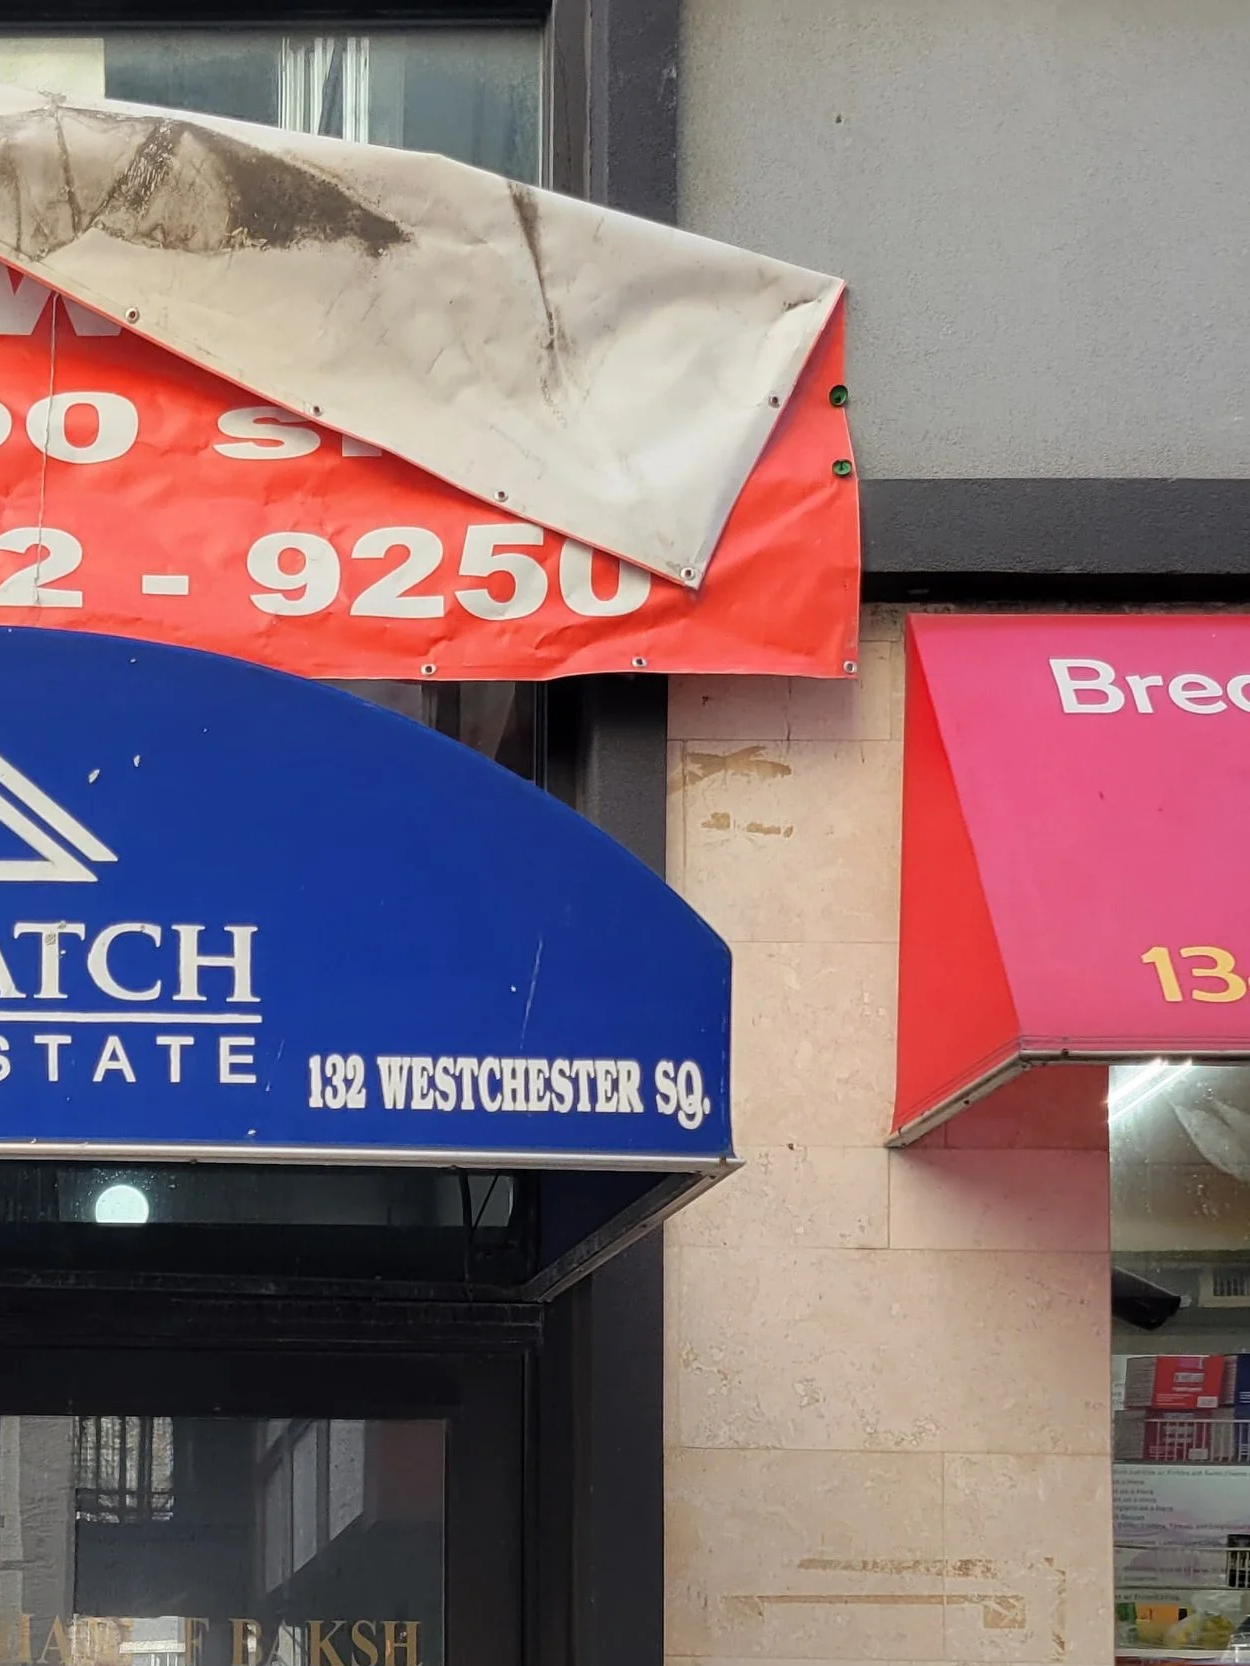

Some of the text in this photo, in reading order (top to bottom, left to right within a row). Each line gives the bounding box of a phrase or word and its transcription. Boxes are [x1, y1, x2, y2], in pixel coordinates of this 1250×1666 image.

[141, 575, 190, 596] -
[244, 523, 652, 622] 9250
[1141, 945, 1250, 1004] 13
[308, 1053, 712, 1131] 132 WESTCHESTER SQ.
